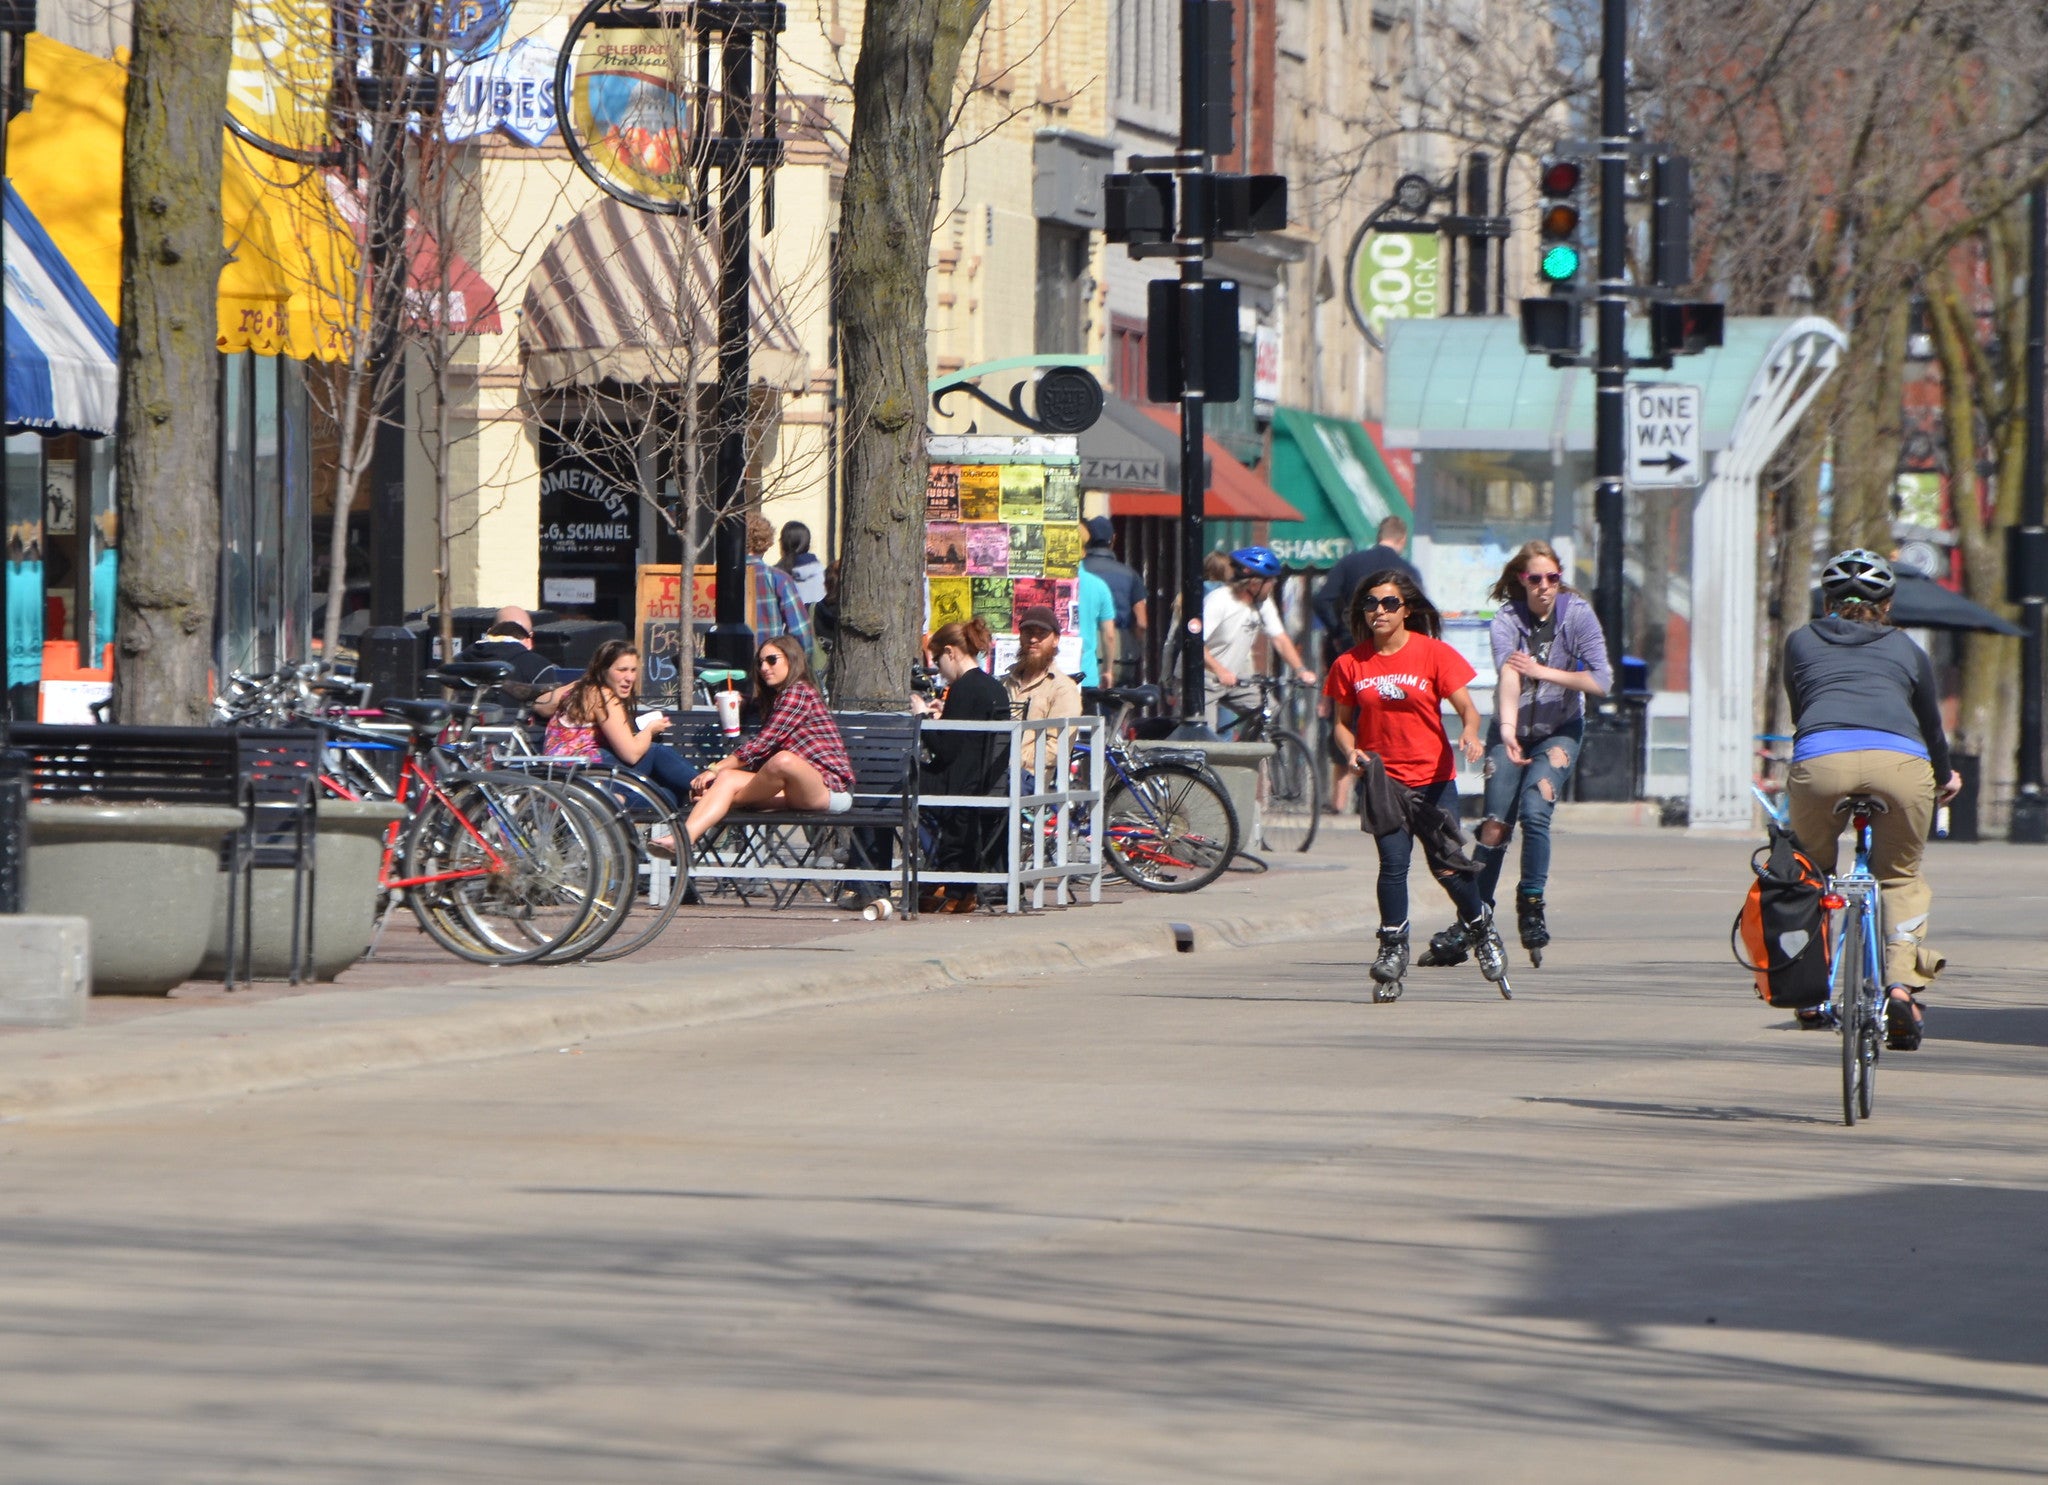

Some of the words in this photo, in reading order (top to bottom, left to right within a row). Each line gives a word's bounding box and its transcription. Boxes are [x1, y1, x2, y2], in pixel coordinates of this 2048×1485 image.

[227, 0, 288, 115] 40
[597, 44, 669, 56] CELEBRAT
[1638, 396, 1692, 419] ONE
[1637, 425, 1692, 446] WAY
[960, 470, 999, 478] tobacco
[566, 523, 632, 539] SCHANEL
[647, 600, 716, 618] thra
[648, 655, 678, 682] US
